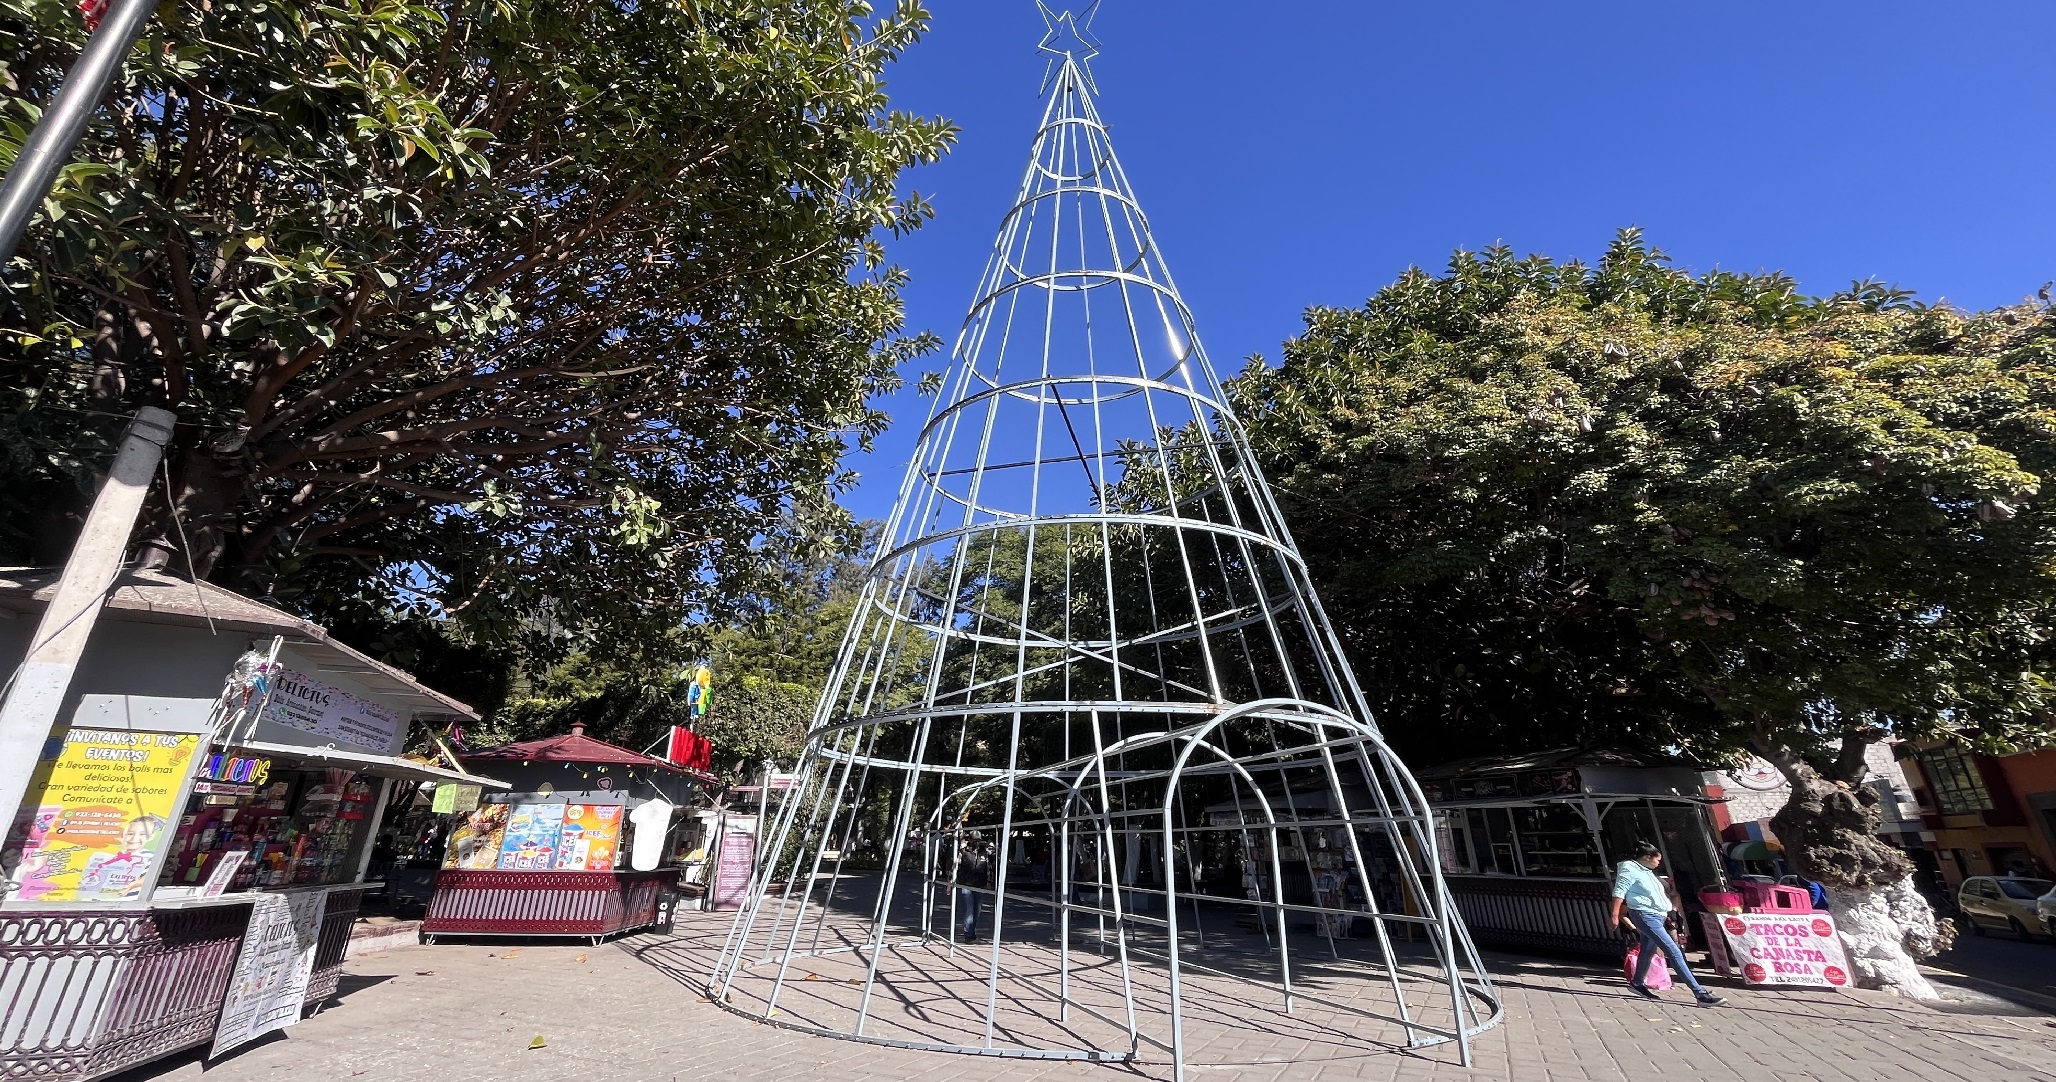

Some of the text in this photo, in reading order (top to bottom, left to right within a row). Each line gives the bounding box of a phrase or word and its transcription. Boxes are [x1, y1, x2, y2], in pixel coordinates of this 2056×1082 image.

[140, 734, 151, 746] A
[154, 735, 179, 748] TUS
[85, 747, 151, 762] EVENTOS!
[65, 760, 111, 771] llevamos
[113, 762, 126, 772] los
[128, 762, 151, 774] bolis
[152, 766, 173, 774] mas
[84, 772, 134, 784] deliciosos!
[38, 781, 168, 795] Gran variedad de sabores
[62, 793, 124, 804] Comunícate
[1750, 923, 1809, 938] TACOS
[1765, 936, 1803, 948] DE LA
[1749, 947, 1827, 963] CANASTA
[1772, 961, 1813, 975] ROSA
